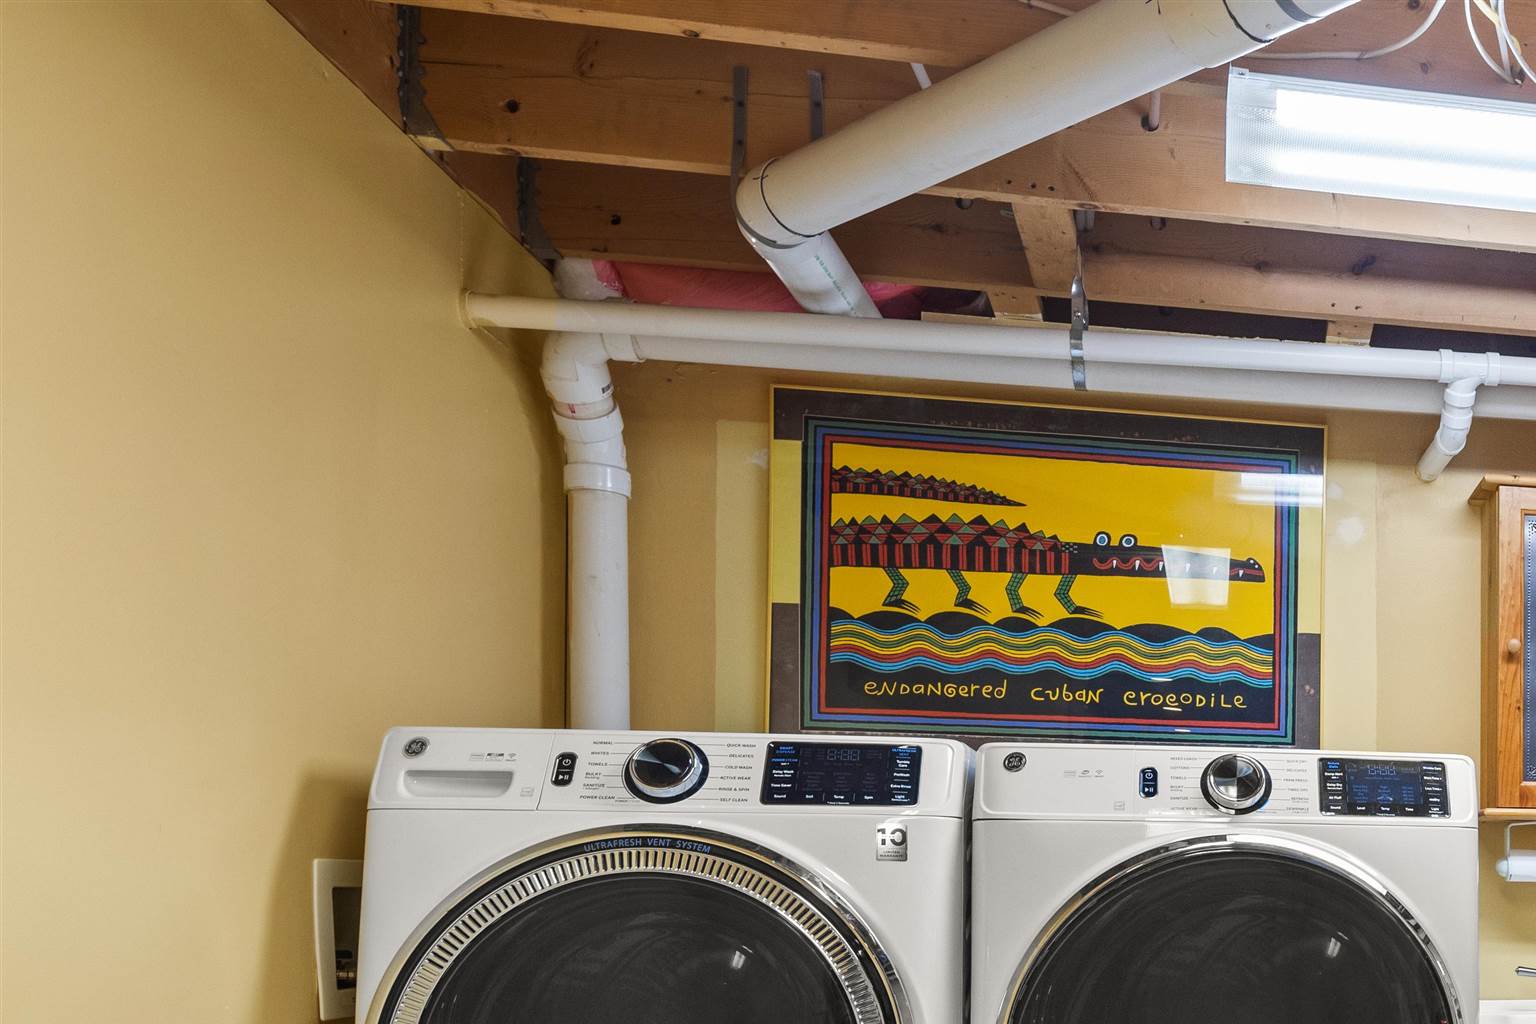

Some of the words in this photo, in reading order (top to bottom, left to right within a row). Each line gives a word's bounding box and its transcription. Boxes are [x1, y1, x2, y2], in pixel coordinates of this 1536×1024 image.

[583, 838, 642, 852] ULTRAFRESH
[647, 838, 671, 847] VENT
[675, 840, 711, 853] SYSTEM
